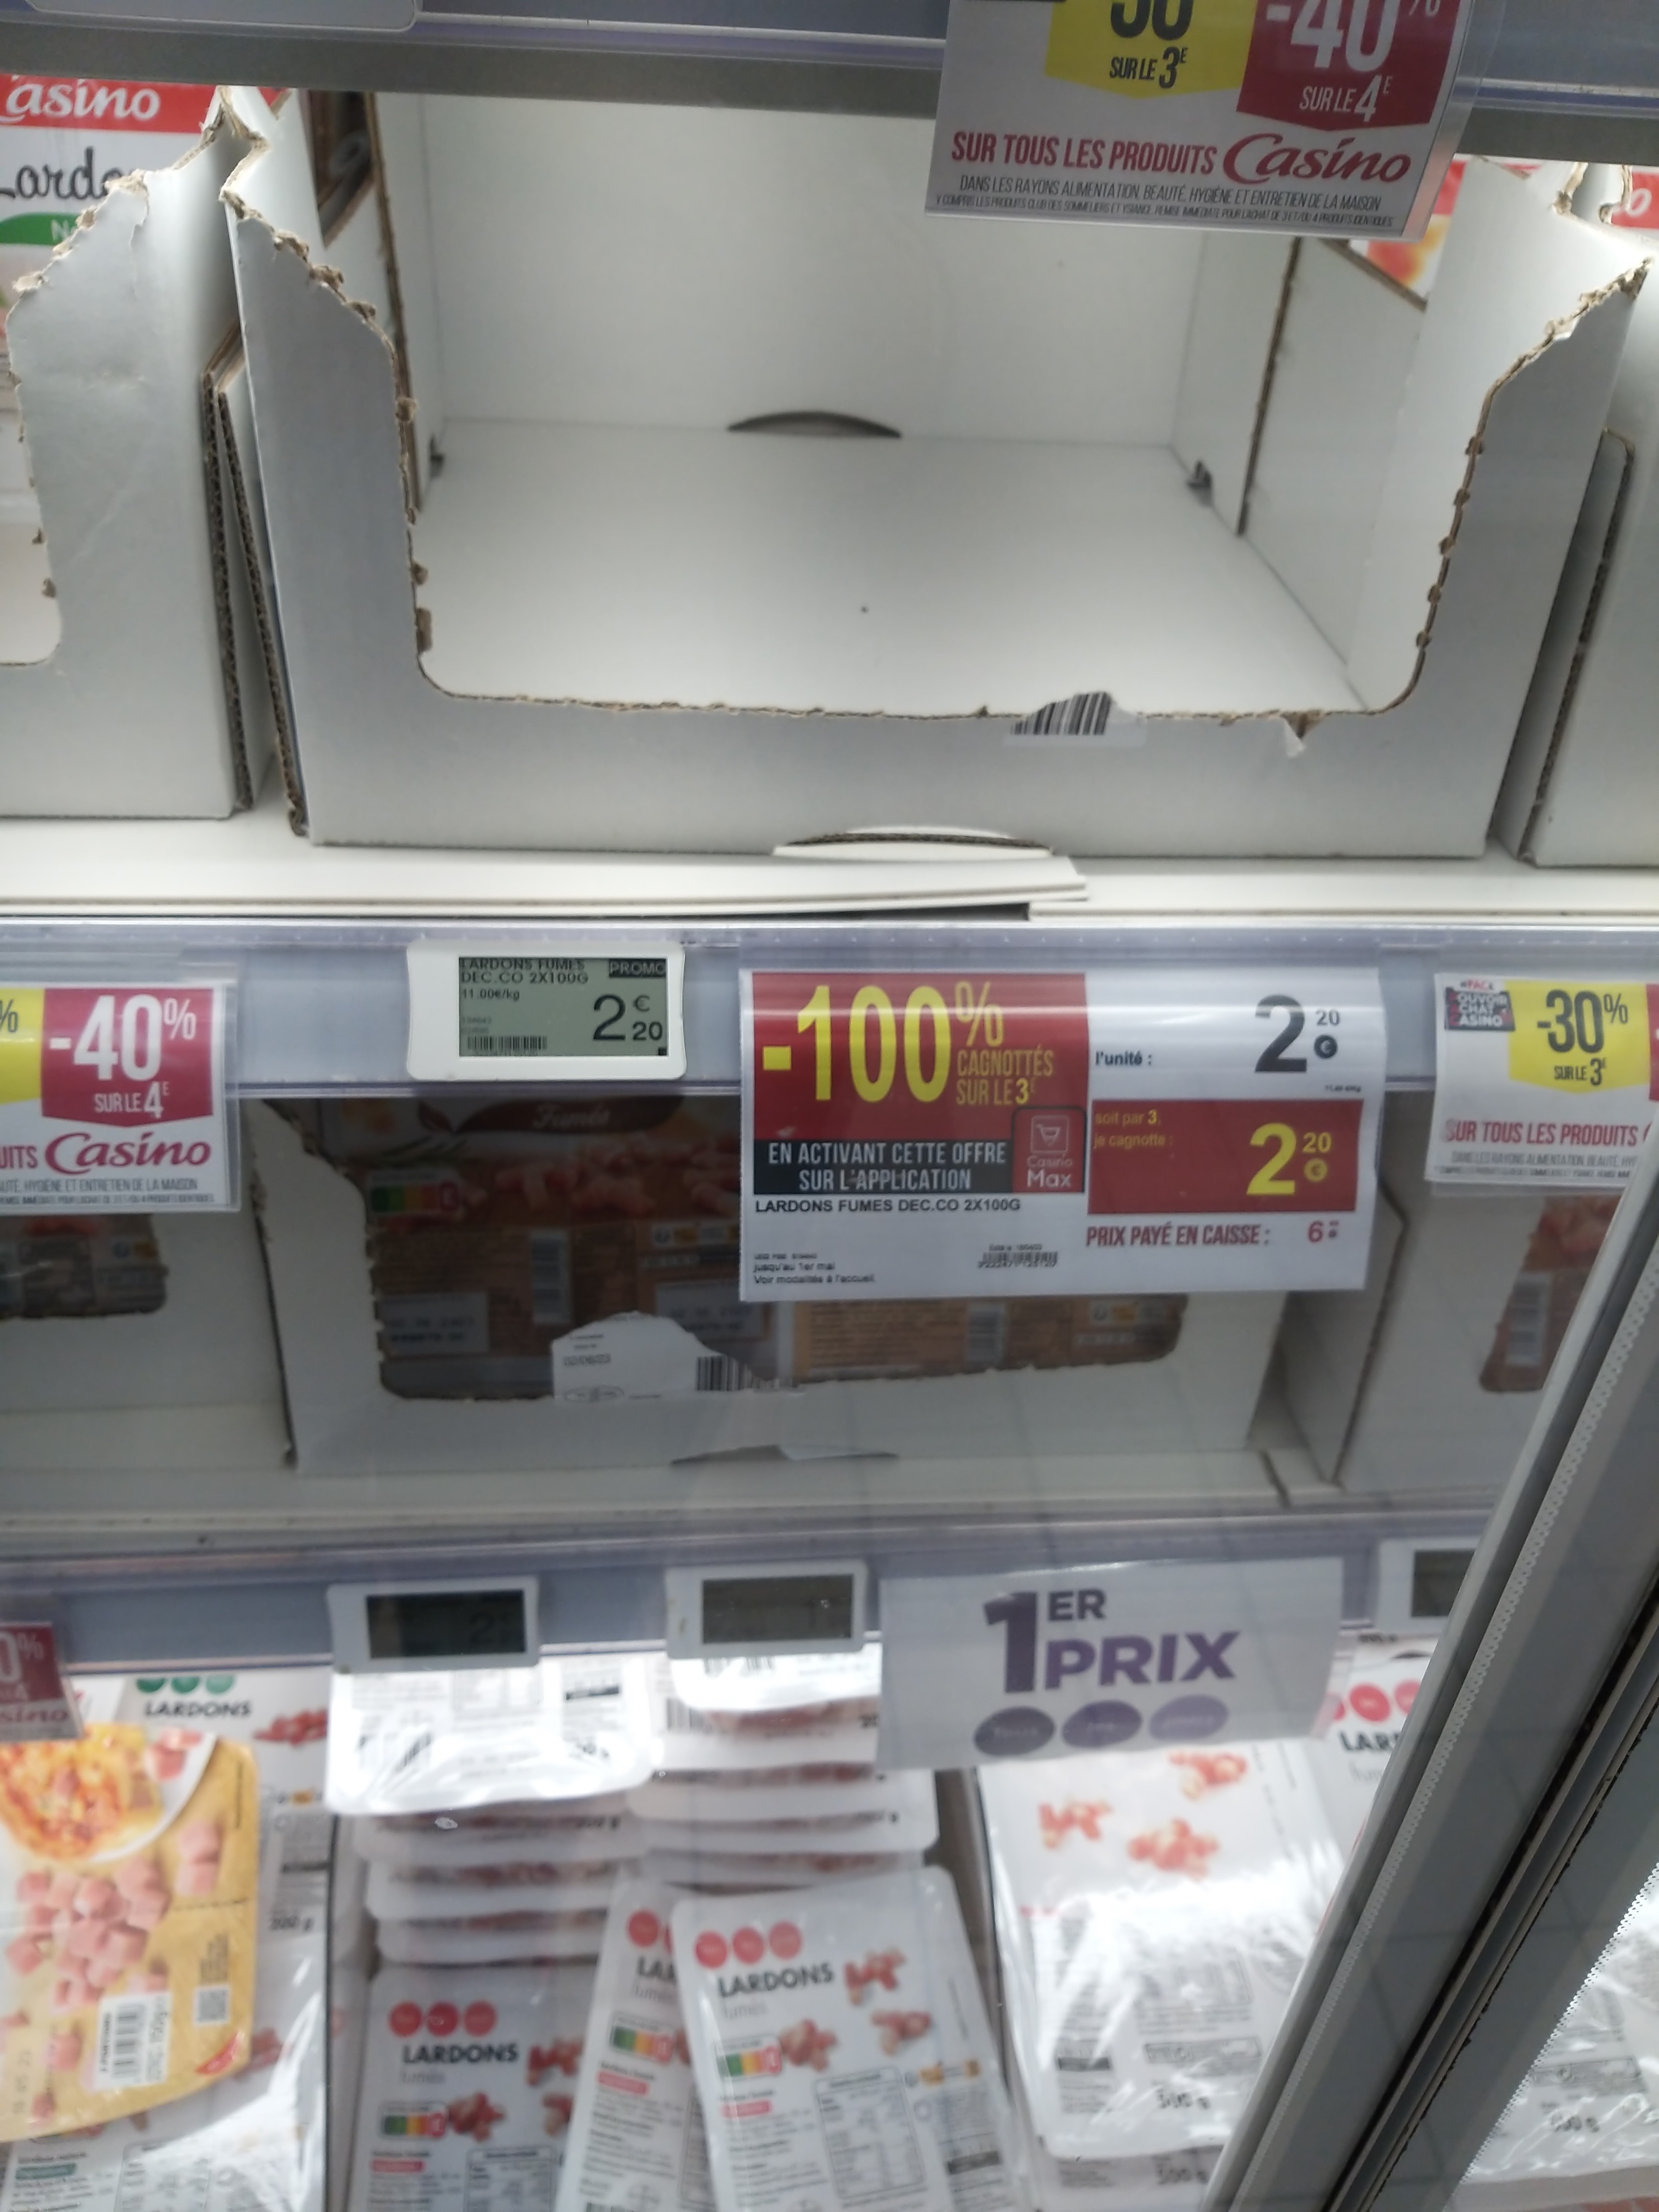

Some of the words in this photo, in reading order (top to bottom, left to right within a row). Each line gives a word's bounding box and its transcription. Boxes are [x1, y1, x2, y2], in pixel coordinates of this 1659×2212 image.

[1109, 56, 1137, 80] SUR
[1138, 58, 1158, 80] LE
[0, 76, 161, 123] asino
[1299, 85, 1333, 111] SUR
[1333, 89, 1356, 113] LE
[952, 131, 997, 163] SUR
[1004, 134, 1060, 167] TOUS
[1063, 137, 1106, 169] LES
[1108, 141, 1218, 175] PRODUITS
[1223, 133, 1411, 185] Casino
[960, 174, 991, 192] DANS
[992, 176, 1013, 193] LES
[1015, 177, 1060, 195] RAYONS
[1234, 189, 1250, 204] ET
[1250, 190, 1308, 209] ENTRETIEN
[1308, 193, 1324, 209] DE
[1323, 194, 1338, 210] LA
[1339, 194, 1382, 212] MAISON
[529, 972, 589, 984] 2X100G
[610, 961, 666, 975] PROMO
[593, 994, 626, 1040] 2
[1537, 989, 1628, 1054] -30%
[49, 994, 196, 1081] -40%
[632, 1021, 664, 1041] 20
[763, 981, 1004, 1103] -100%
[1255, 994, 1308, 1072] 2
[1314, 1008, 1341, 1026] 20
[957, 1043, 1054, 1077] CAGNOTTÉS
[1554, 1065, 1574, 1081] SUR
[1575, 1066, 1588, 1081] LE
[94, 1093, 124, 1113] SUR
[125, 1093, 142, 1113] LE
[956, 1078, 989, 1106] SUR
[994, 1079, 1013, 1106] LE
[1122, 1113, 1144, 1128] par
[1446, 1118, 1477, 1143] SUR
[1482, 1121, 1523, 1144] TOUS
[1526, 1122, 1557, 1145] LES
[1560, 1123, 1639, 1147] PRODUITS
[45, 1132, 211, 1176] Casino
[768, 1142, 792, 1165] EN
[798, 1142, 886, 1165] ACTIVANT
[892, 1142, 947, 1165] CETTE
[952, 1142, 1007, 1165] OFFRE
[1109, 1134, 1166, 1151] cagnotte
[1026, 1153, 1073, 1168] Casino
[1246, 1122, 1296, 1196] 2
[1303, 1133, 1332, 1154] 20
[799, 1170, 834, 1191] SUR
[840, 1169, 972, 1191] L'APPLICATION
[1027, 1168, 1072, 1188] Max
[756, 1200, 833, 1212] LARDONS
[838, 1199, 893, 1211] FUMES
[898, 1199, 959, 1211] DEC.CO
[964, 1198, 1021, 1211] 2X100G
[1086, 1225, 1126, 1247] PRIX
[1131, 1221, 1172, 1246] PAYÉ
[1176, 1224, 1199, 1245] EN
[1202, 1224, 1261, 1245] CAISSE
[1307, 1220, 1324, 1243] 6
[754, 1275, 774, 1284] Voir
[1044, 1629, 1241, 1691] PRIX
[144, 1700, 251, 1718] LARDONS
[717, 1961, 835, 1998] LARDONS
[402, 2041, 519, 2066] LARDONS
